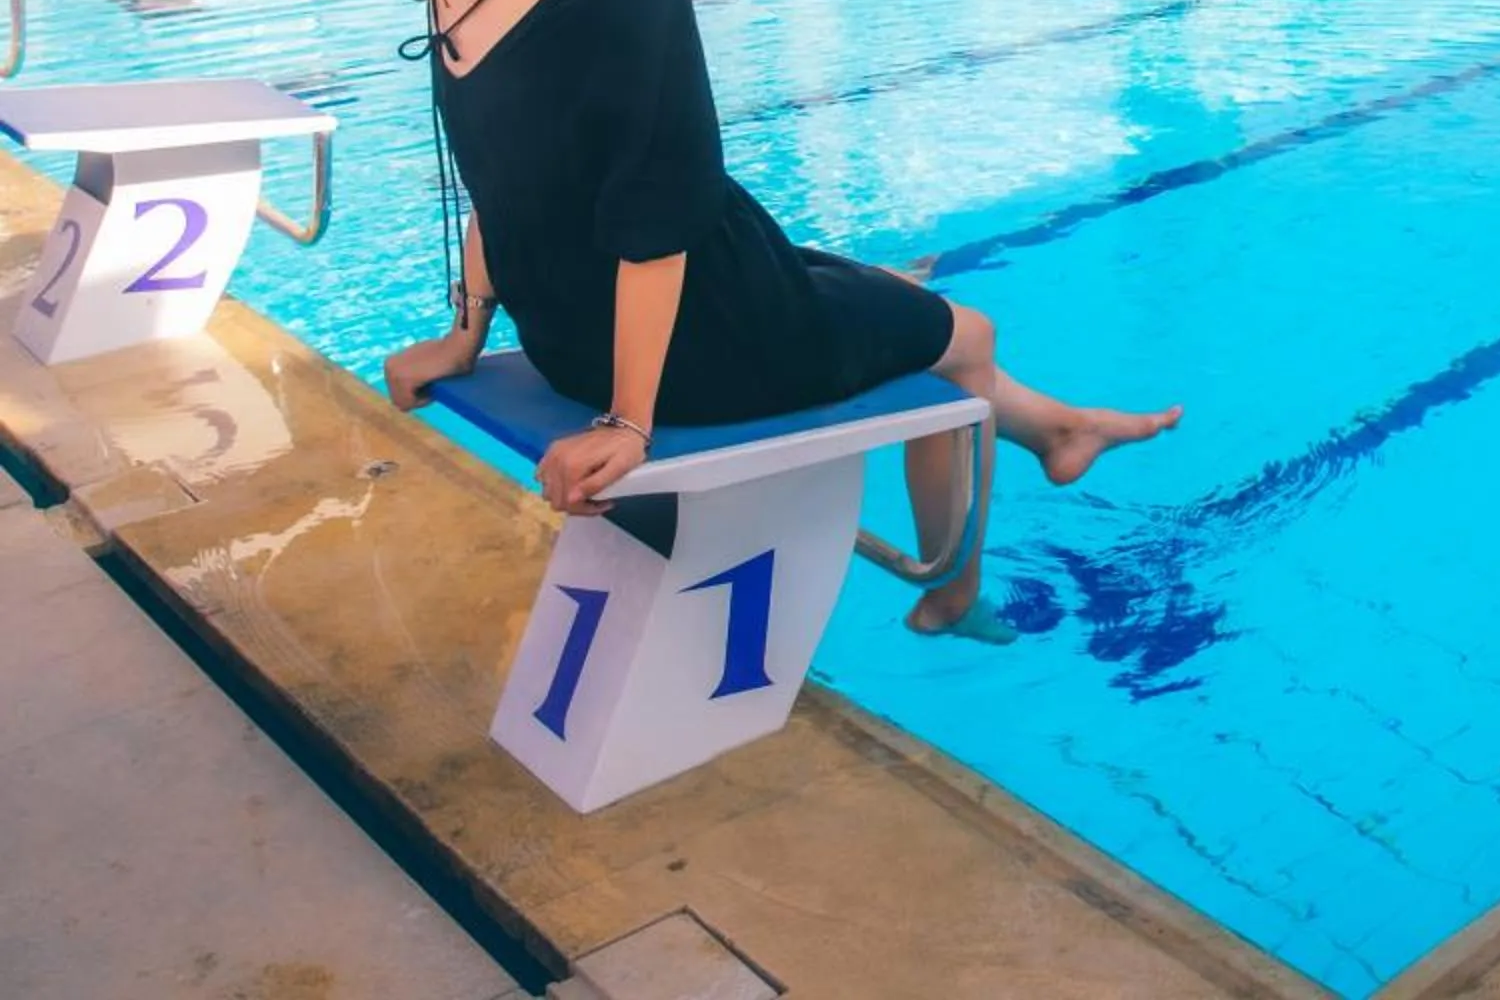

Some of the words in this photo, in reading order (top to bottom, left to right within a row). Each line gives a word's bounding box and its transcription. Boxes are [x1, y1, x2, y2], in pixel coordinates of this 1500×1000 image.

[31, 219, 81, 319] 2
[122, 197, 208, 294] 2
[533, 584, 610, 743] 1
[677, 548, 776, 700] 1
